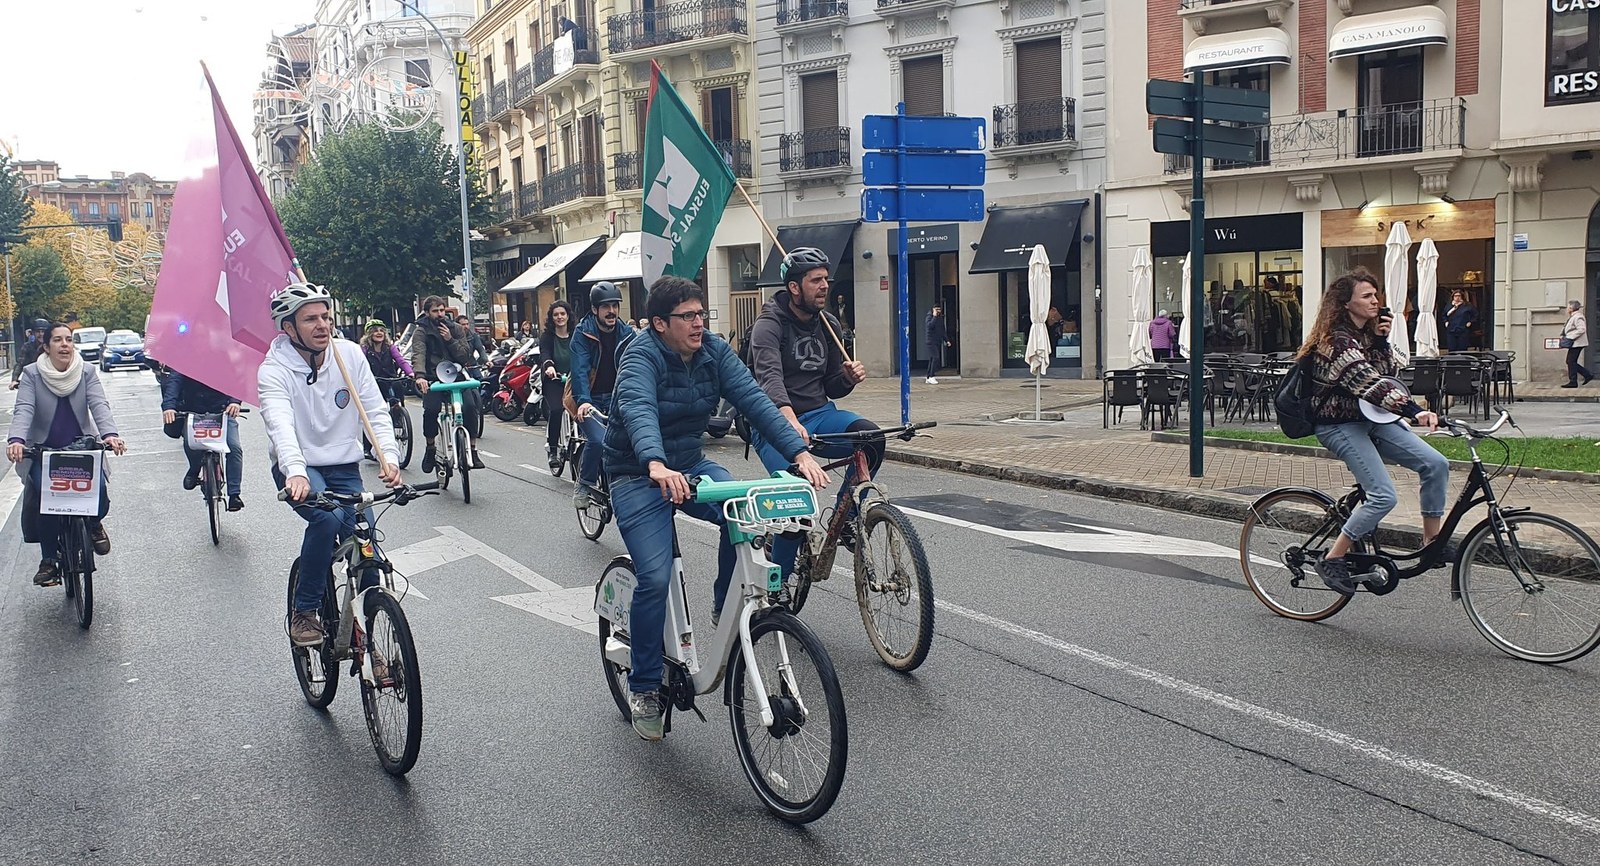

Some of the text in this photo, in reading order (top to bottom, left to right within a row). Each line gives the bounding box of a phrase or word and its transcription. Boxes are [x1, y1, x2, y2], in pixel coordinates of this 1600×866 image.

[1342, 24, 1426, 44] CASA MANOLO
[1198, 44, 1265, 60] RESTAURANTE
[455, 51, 472, 126] ULLOA
[1214, 228, 1237, 240] Wú
[737, 262, 753, 278] 14
[193, 428, 222, 438] 30
[50, 478, 92, 492] 30
